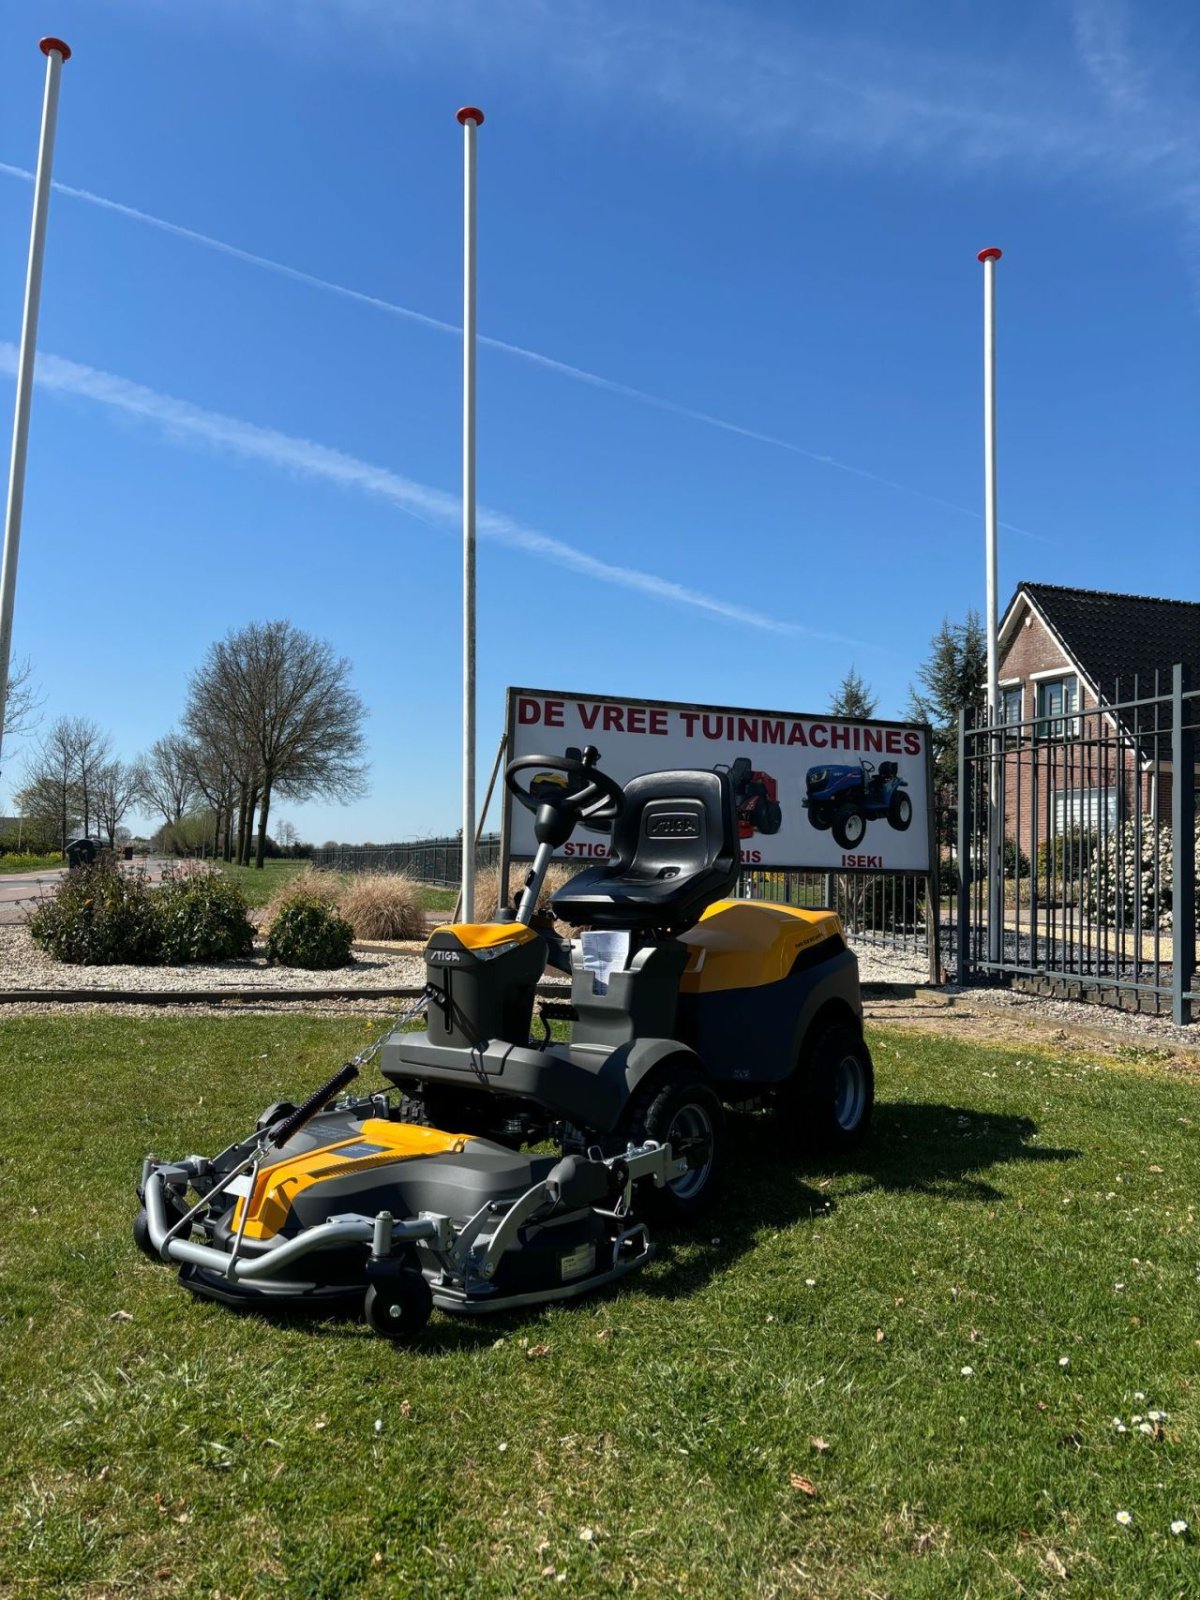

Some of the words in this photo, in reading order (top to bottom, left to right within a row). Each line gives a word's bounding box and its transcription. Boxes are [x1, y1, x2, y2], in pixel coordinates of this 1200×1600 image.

[518, 698, 565, 727] DE
[577, 703, 669, 736] VREE
[680, 713, 920, 755] TUINMACHINES
[841, 854, 883, 868] ISEKI
[430, 951, 460, 962] STIGA
